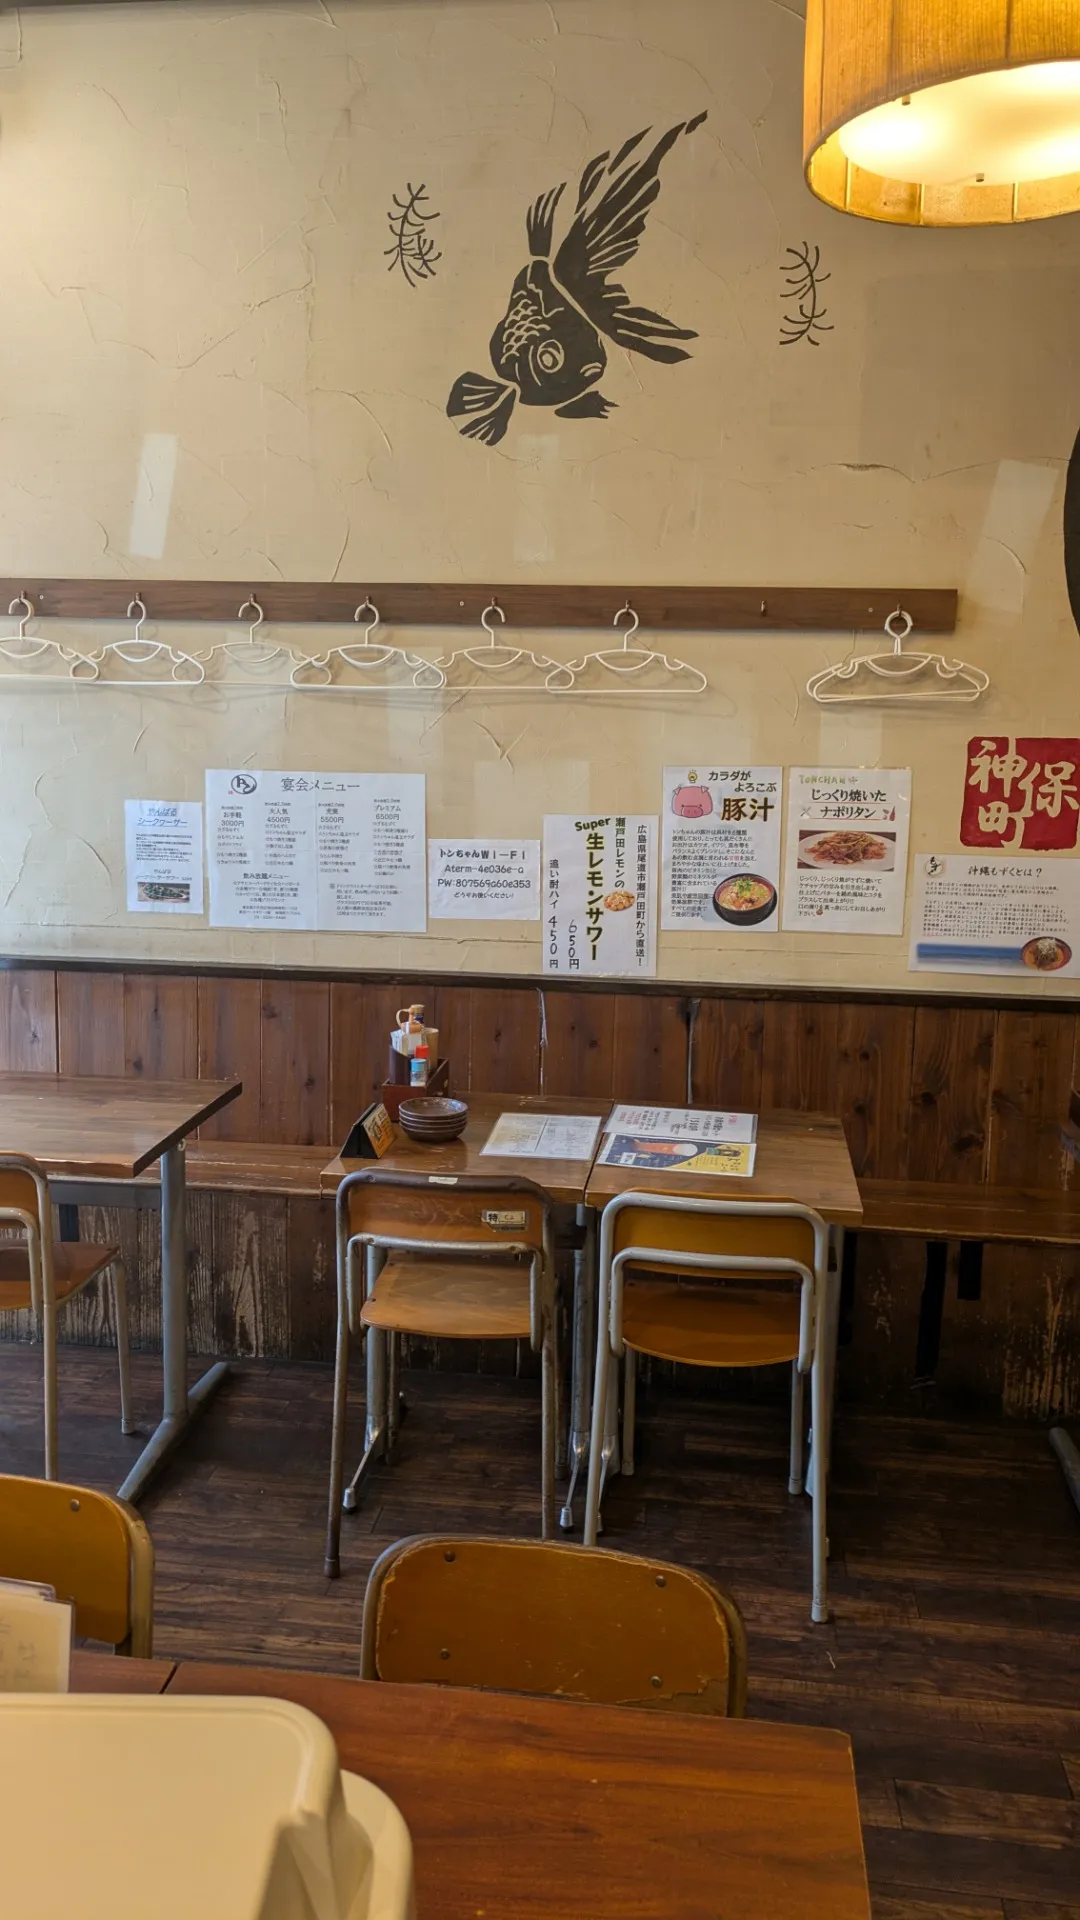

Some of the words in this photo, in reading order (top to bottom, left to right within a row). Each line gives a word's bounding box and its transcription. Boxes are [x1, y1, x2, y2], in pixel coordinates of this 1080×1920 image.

[708, 770, 751, 781] カラダが
[281, 777, 360, 792] 宴会メニュー
[734, 782, 777, 793] よろこぶ
[811, 788, 887, 802] じっくり焼いた
[374, 804, 402, 812] プレミアム
[721, 797, 775, 822] 豚汁
[820, 805, 876, 819] ナポリタン
[223, 811, 242, 819] お手軽
[267, 816, 291, 824] 4500円
[320, 816, 344, 824] 5500円
[375, 813, 400, 821] 6500円
[574, 817, 612, 832] Super
[614, 817, 626, 888] 瀬戸田レモンの
[444, 864, 524, 874] Aterm-4e036e-a
[243, 872, 290, 880] 飲み放題メニュー
[585, 832, 605, 961] 生レモンサワー
[568, 919, 580, 970] 650円
